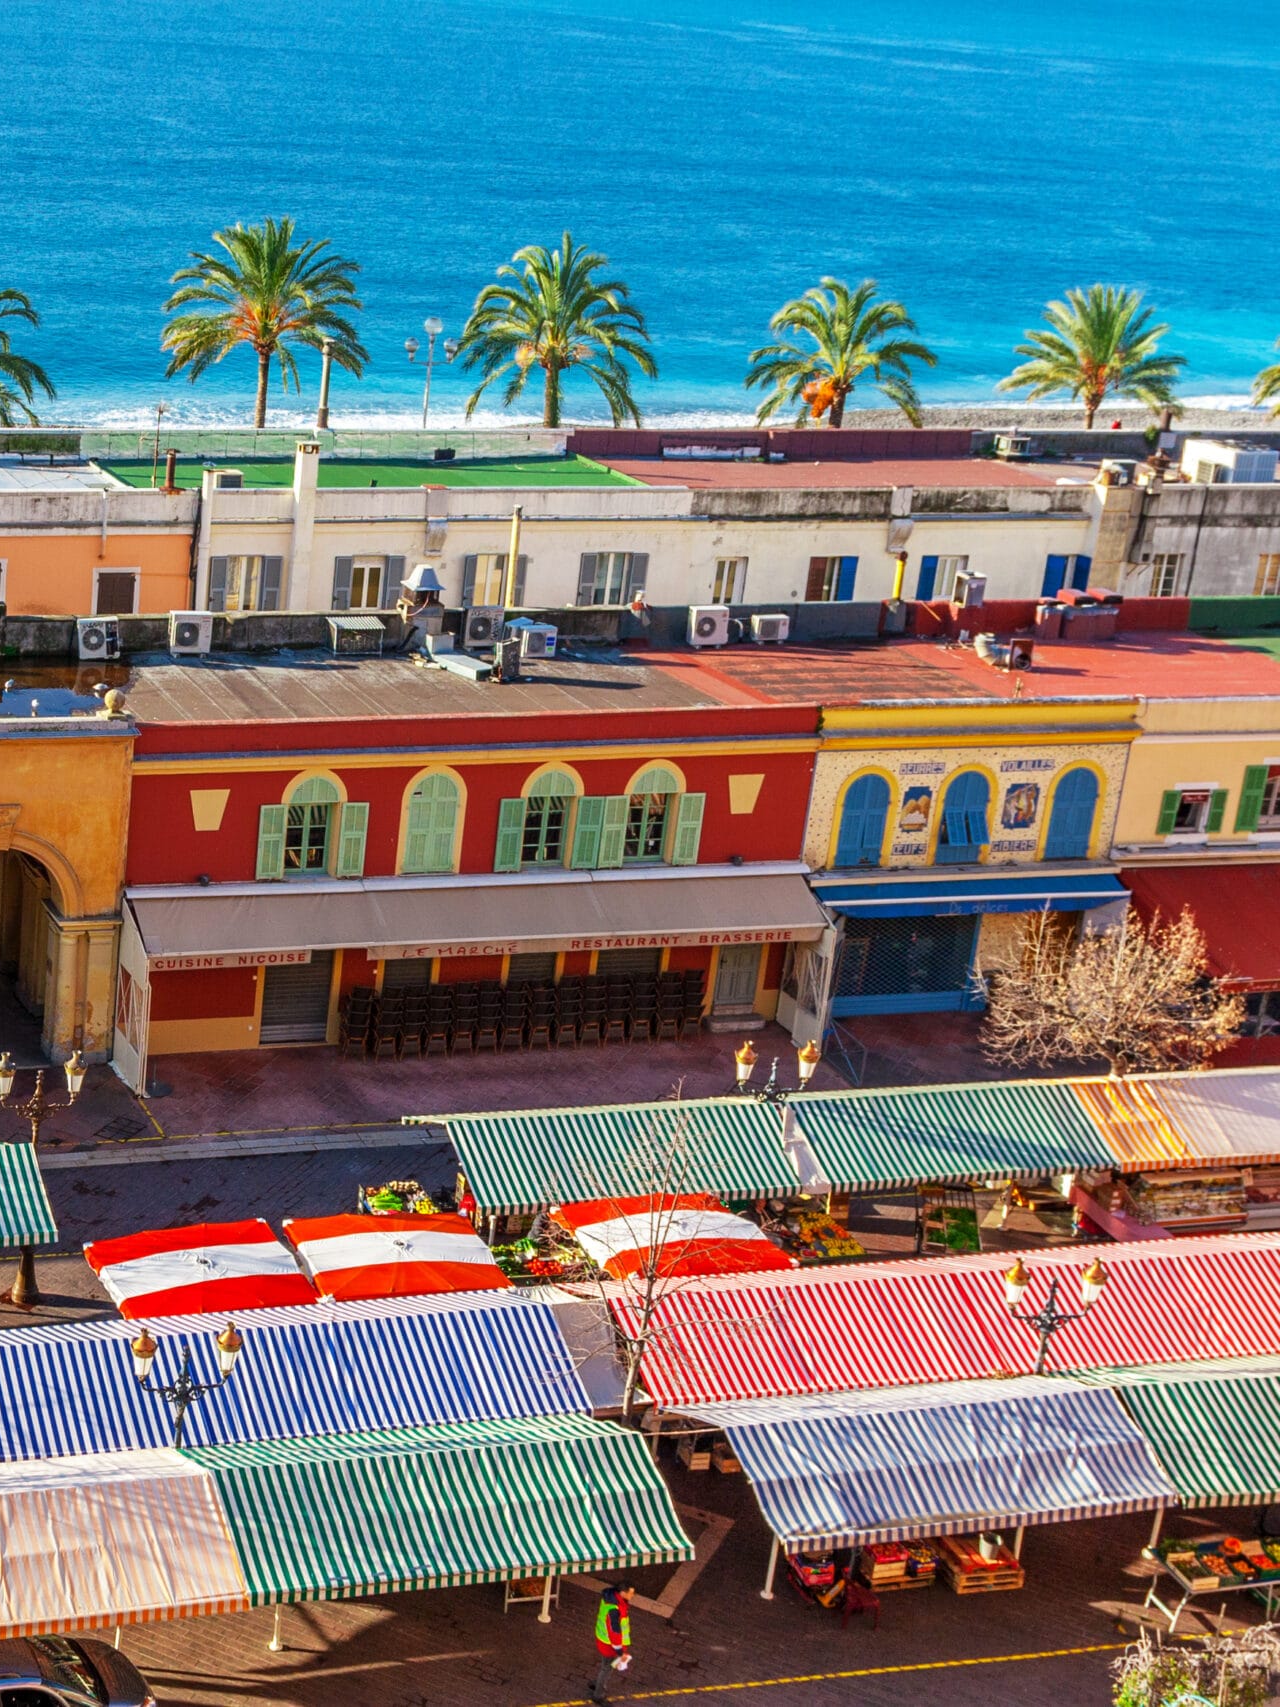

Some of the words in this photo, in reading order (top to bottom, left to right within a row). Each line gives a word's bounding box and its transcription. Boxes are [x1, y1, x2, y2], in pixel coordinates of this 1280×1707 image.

[899, 763, 946, 775] BEURRES
[1001, 760, 1054, 772] VOLAILLES
[991, 841, 1036, 852] GIBIERS
[571, 936, 680, 949] RESTAURANT
[699, 931, 793, 944] BRASSERIE
[402, 947, 430, 958] LE
[154, 957, 225, 969] CUISINE
[238, 953, 307, 965] NICOISE
